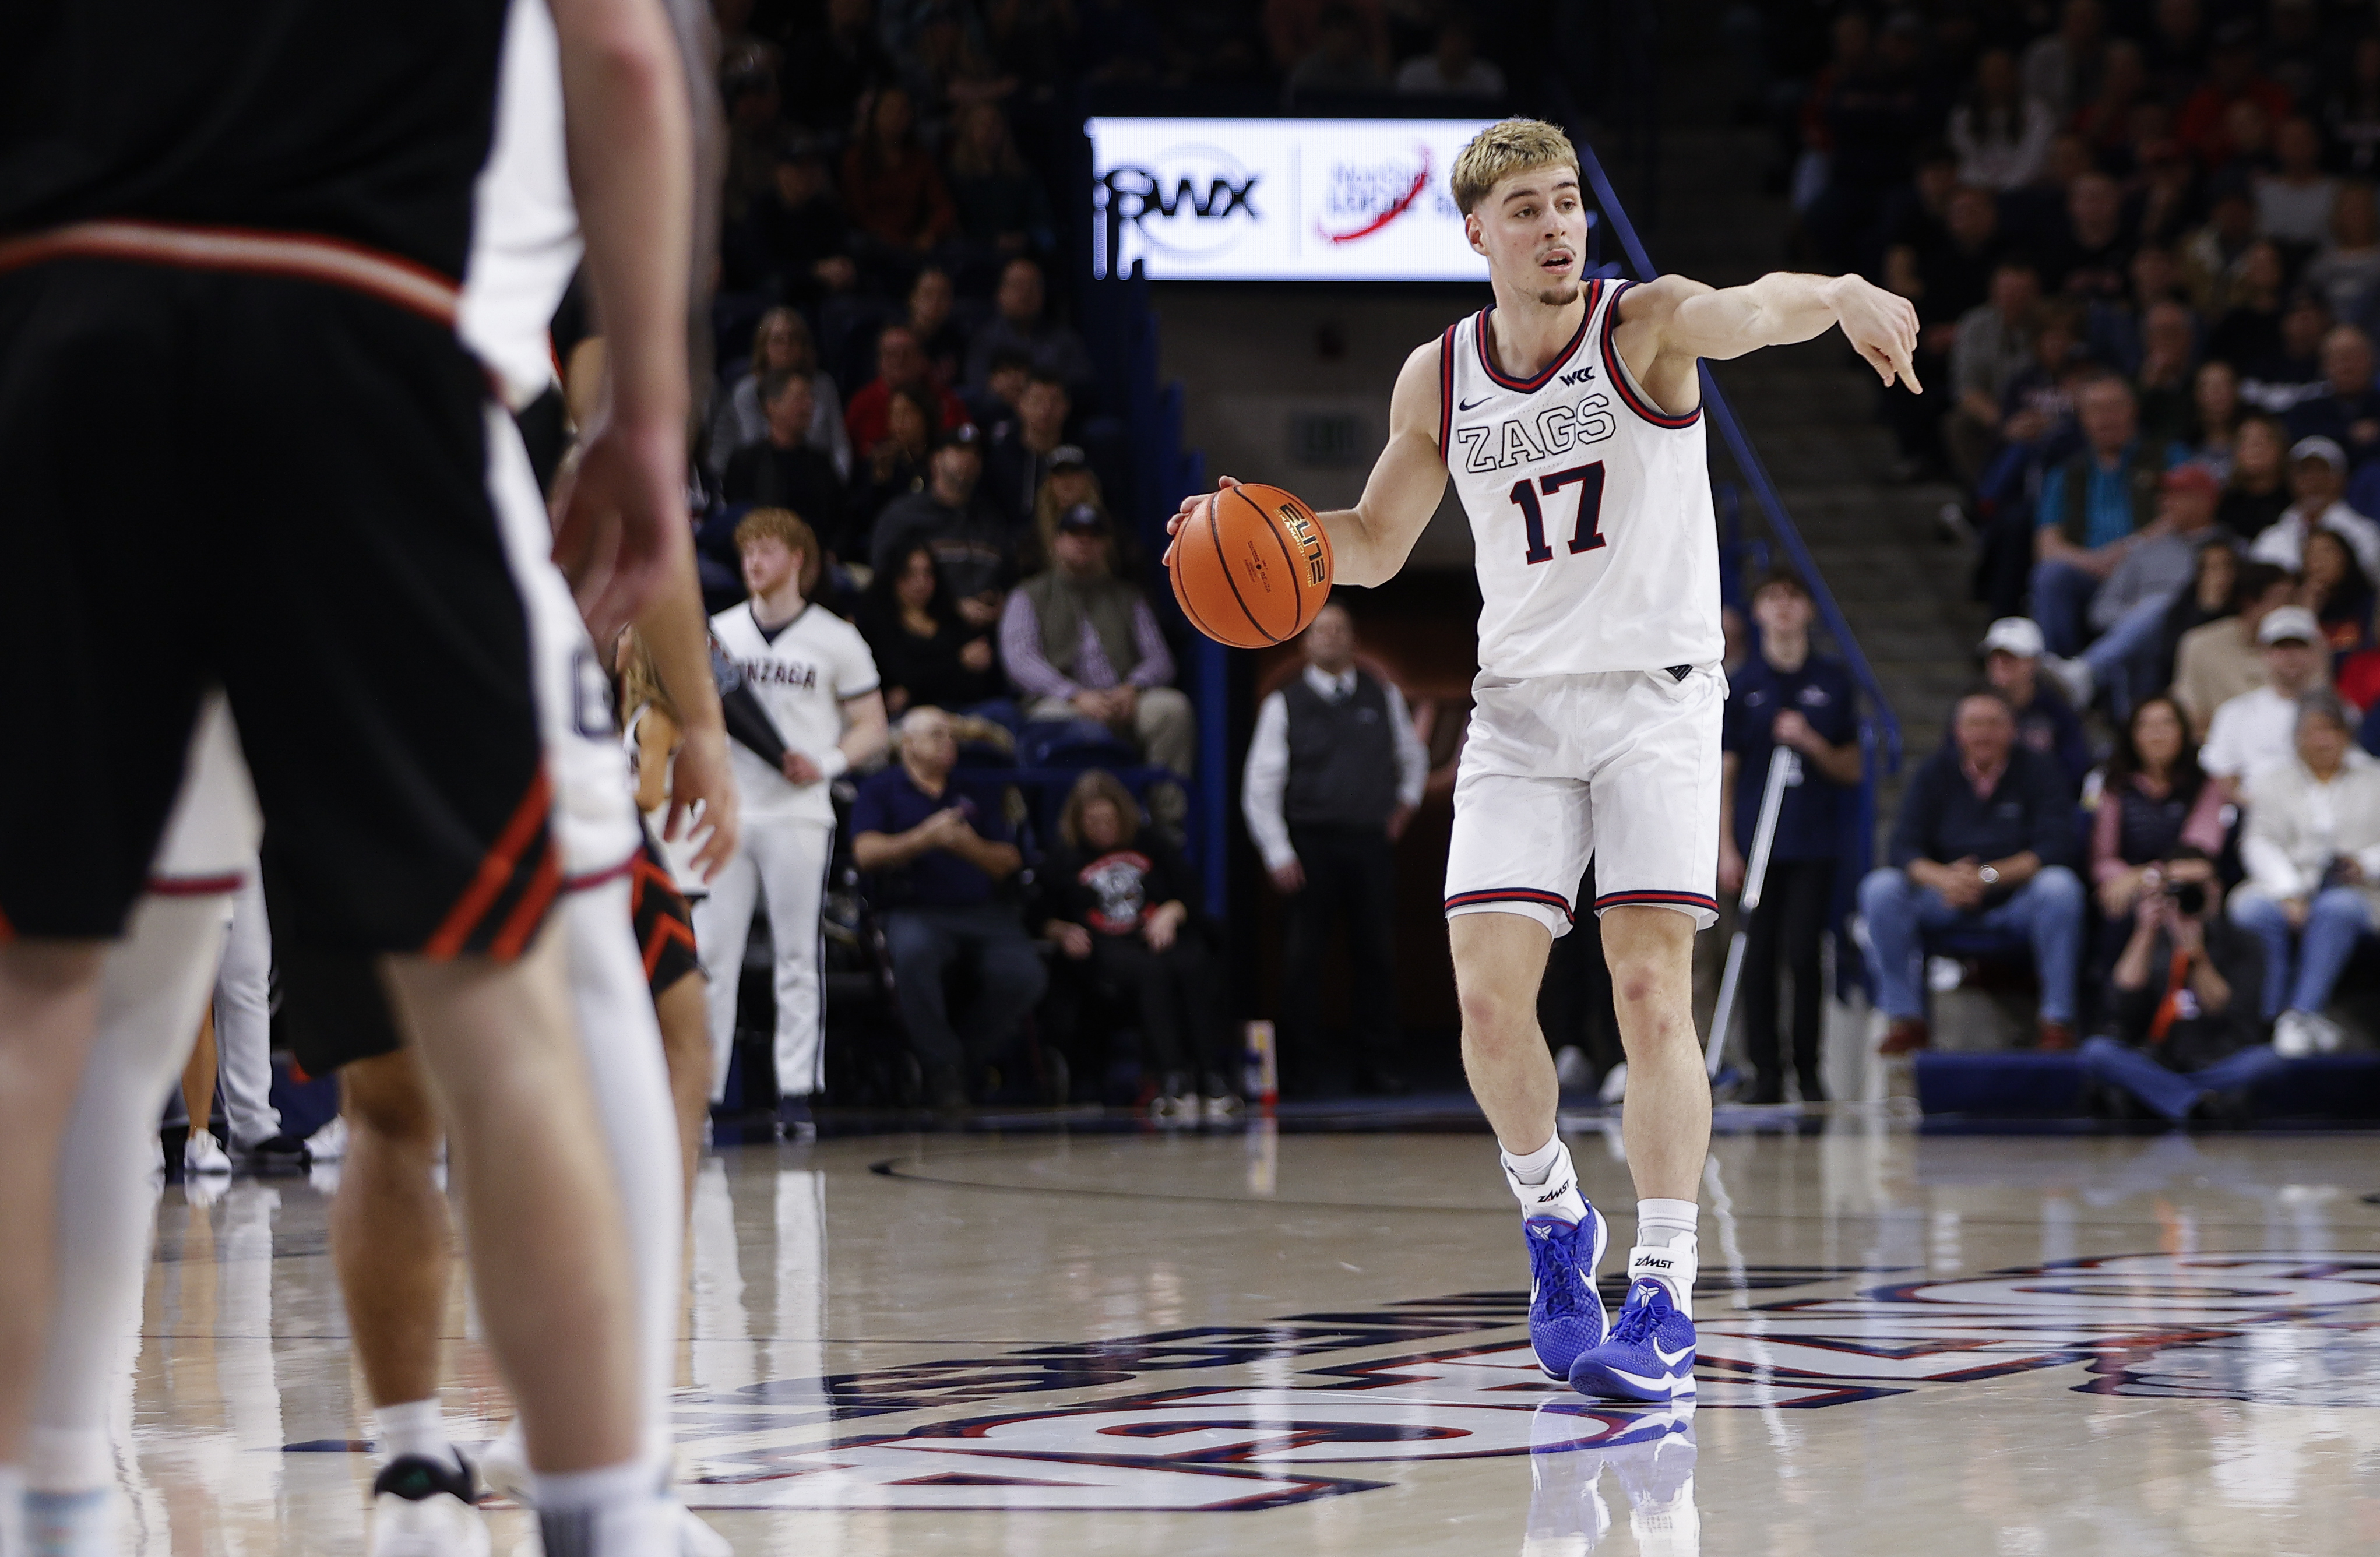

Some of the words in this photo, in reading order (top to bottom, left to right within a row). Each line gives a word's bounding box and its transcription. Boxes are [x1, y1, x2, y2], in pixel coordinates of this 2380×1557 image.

[1559, 365, 1596, 388] WCC
[1457, 393, 1617, 474] ZAGS
[1509, 459, 1607, 565] 17
[1279, 502, 1326, 585] ELITE
[735, 657, 817, 690] NZAGA
[1537, 1178, 1569, 1203] ZAMST
[1633, 1253, 1675, 1269] ZAMST
